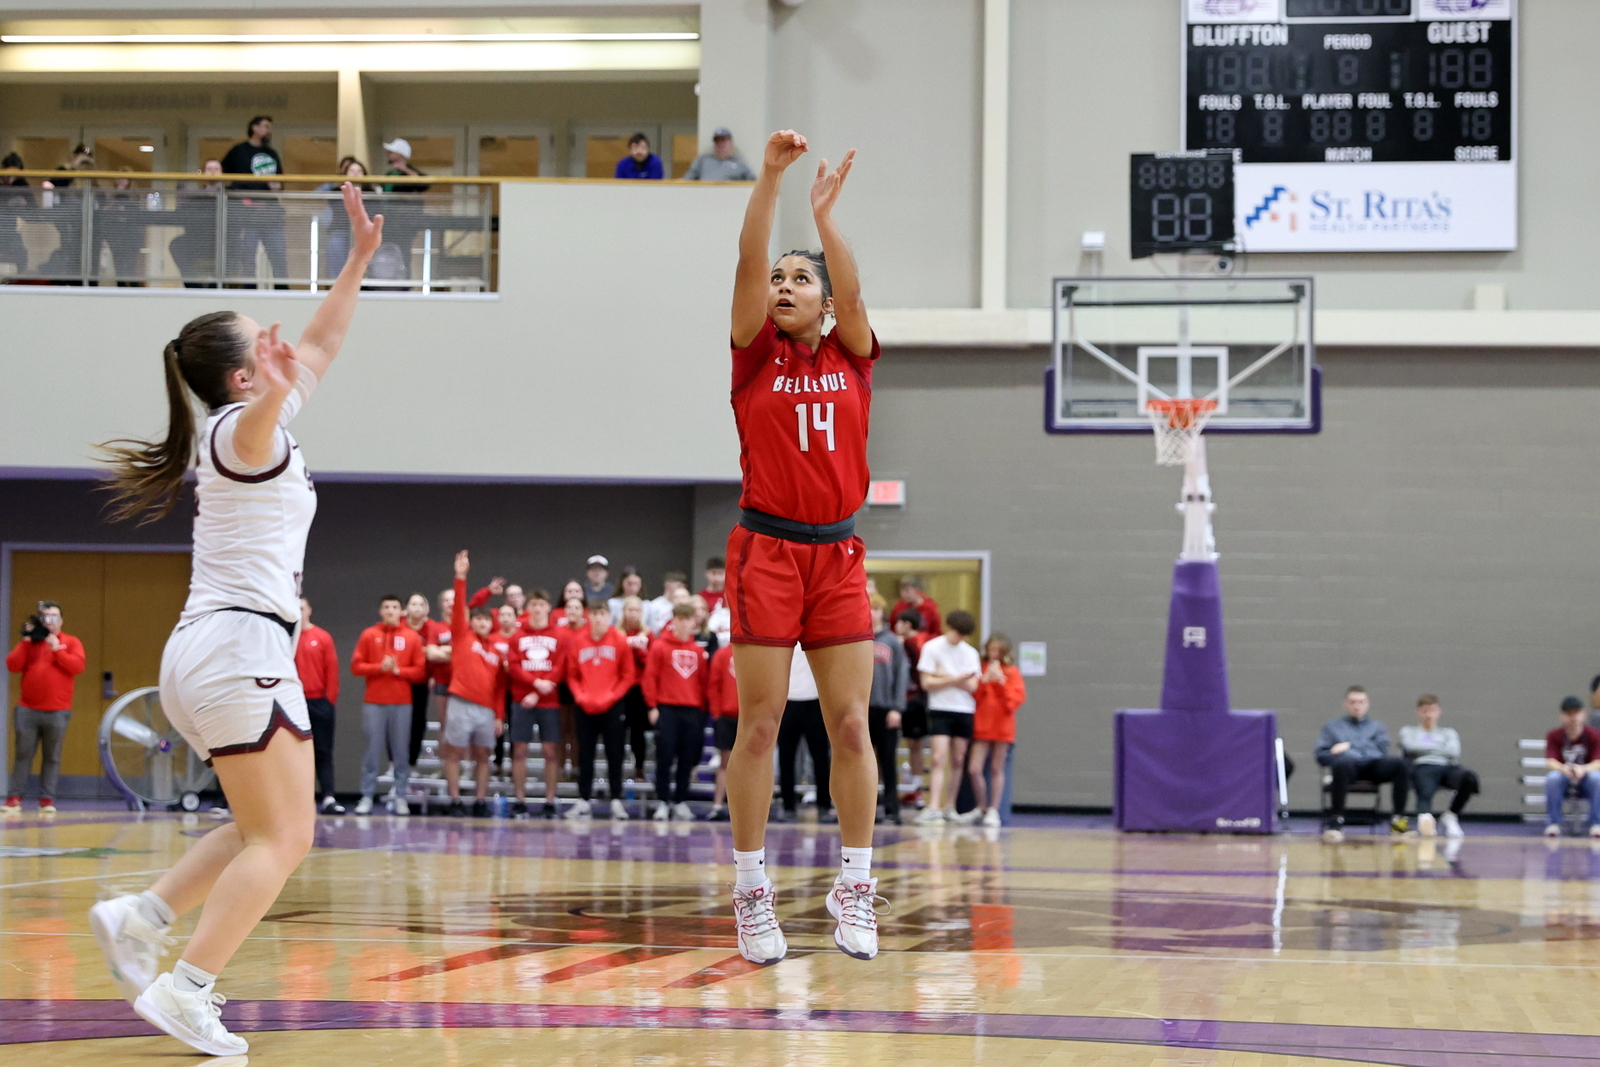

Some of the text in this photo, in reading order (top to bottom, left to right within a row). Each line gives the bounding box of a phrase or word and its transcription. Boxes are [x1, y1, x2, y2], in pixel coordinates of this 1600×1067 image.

[1192, 24, 1289, 46] BLUFFTON
[1323, 33, 1373, 50] PERIOD
[1426, 22, 1492, 44] GUEST
[1199, 94, 1242, 111] FOULS
[1302, 92, 1393, 110] PLAYER FOUL
[1454, 91, 1499, 108] FOULS
[1324, 147, 1373, 162] MATCH
[1454, 146, 1499, 162] SCORE
[772, 371, 848, 395] BELLEVUE
[794, 401, 836, 452] 14
